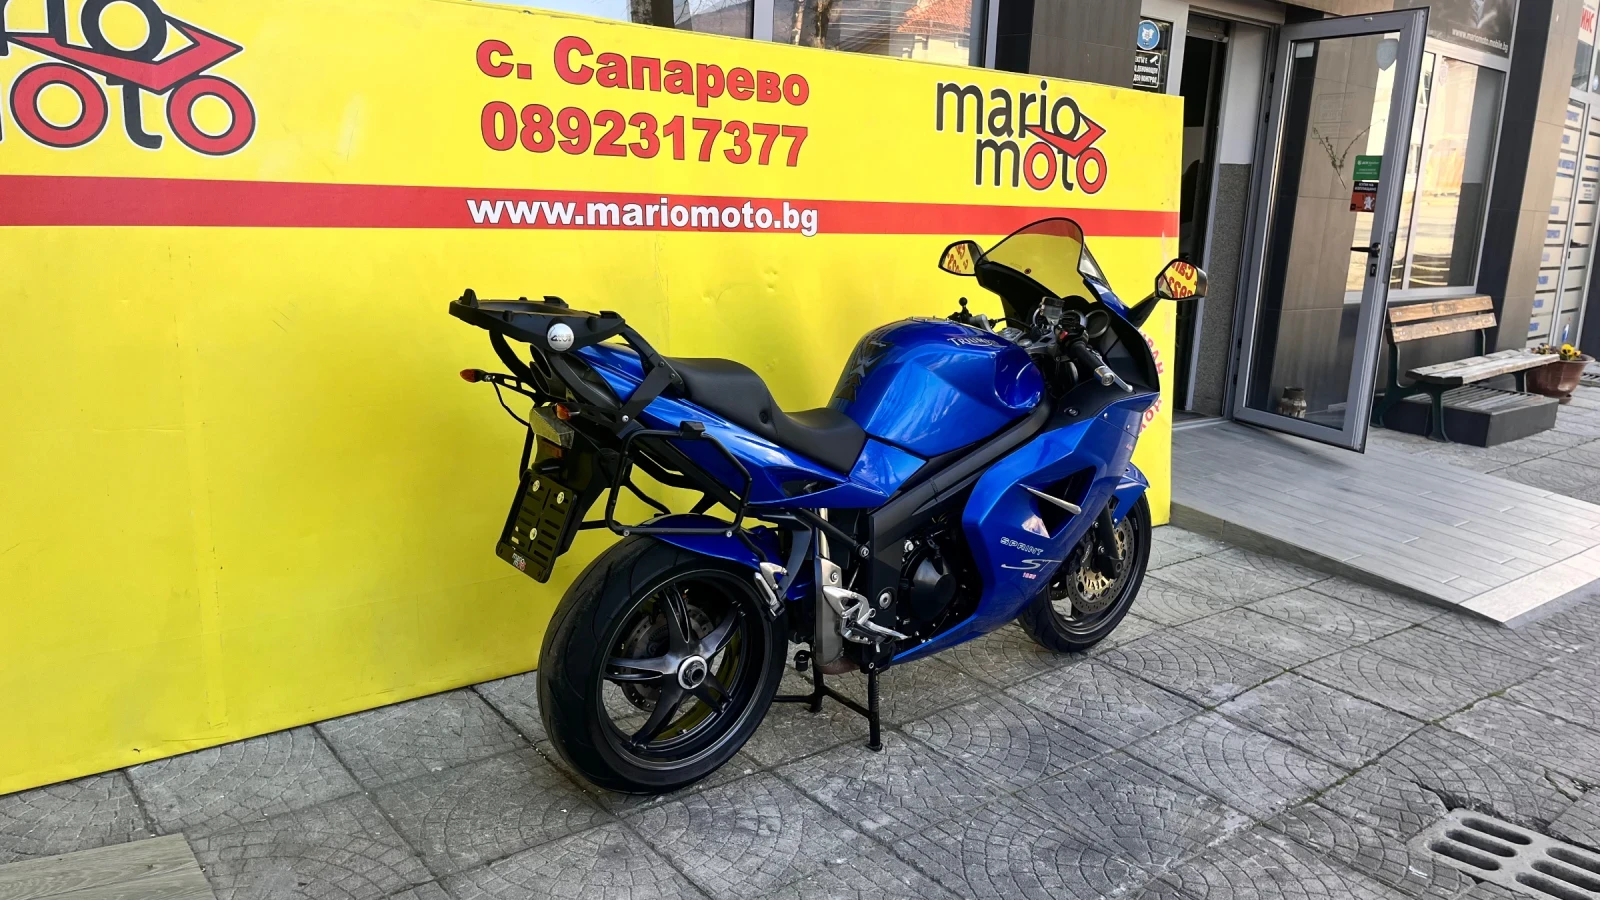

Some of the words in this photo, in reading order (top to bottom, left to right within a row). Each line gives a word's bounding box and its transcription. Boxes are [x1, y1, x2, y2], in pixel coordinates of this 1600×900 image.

[475, 39, 533, 80] с.
[553, 36, 810, 107] Сапарево
[480, 101, 809, 167] 0892317377
[936, 80, 1081, 138] mario
[975, 138, 1107, 194] moto
[467, 197, 819, 237] www.mariomoto.bg
[1000, 536, 1044, 556] SPRINT
[1001, 558, 1062, 573] ST
